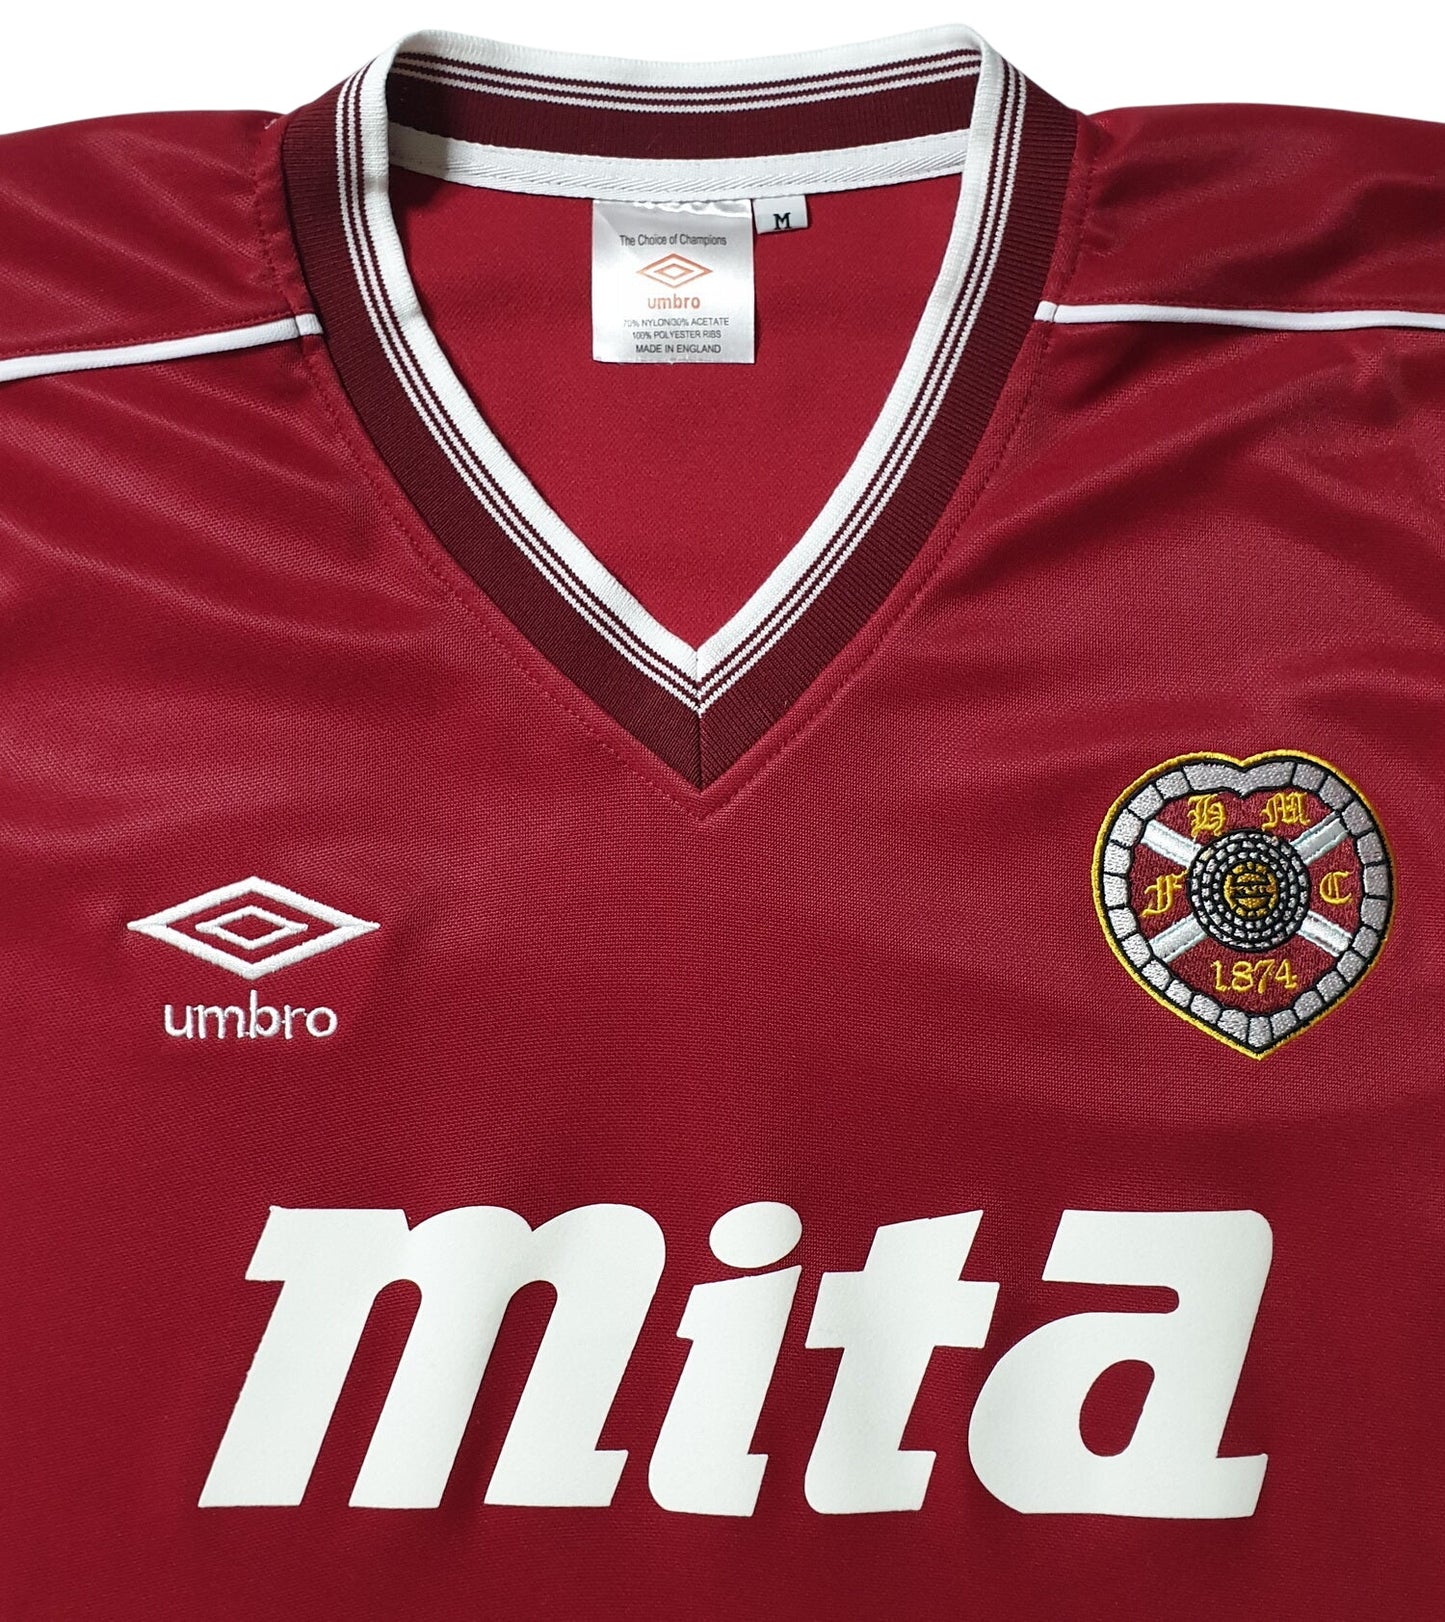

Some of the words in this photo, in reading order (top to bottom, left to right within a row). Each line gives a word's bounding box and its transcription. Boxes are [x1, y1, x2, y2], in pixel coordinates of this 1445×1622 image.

[773, 212, 791, 230] M
[620, 235, 636, 246] The
[638, 234, 667, 246] Choice
[669, 233, 678, 245] of
[680, 233, 727, 247] Champions
[647, 293, 701, 309] umbro
[691, 317, 729, 326] ACETATE
[633, 331, 652, 339] 100%
[654, 330, 701, 339] POLYESTER
[703, 330, 722, 338] RIBS
[636, 344, 662, 353] MADE
[665, 344, 674, 353] IN
[676, 344, 722, 353] ENGLAND
[1261, 792, 1310, 831] M
[1141, 869, 1187, 917] F
[1319, 871, 1352, 905] C
[1210, 959, 1298, 994] 1874
[164, 989, 338, 1040] umbro
[198, 1202, 1273, 1519] mita
